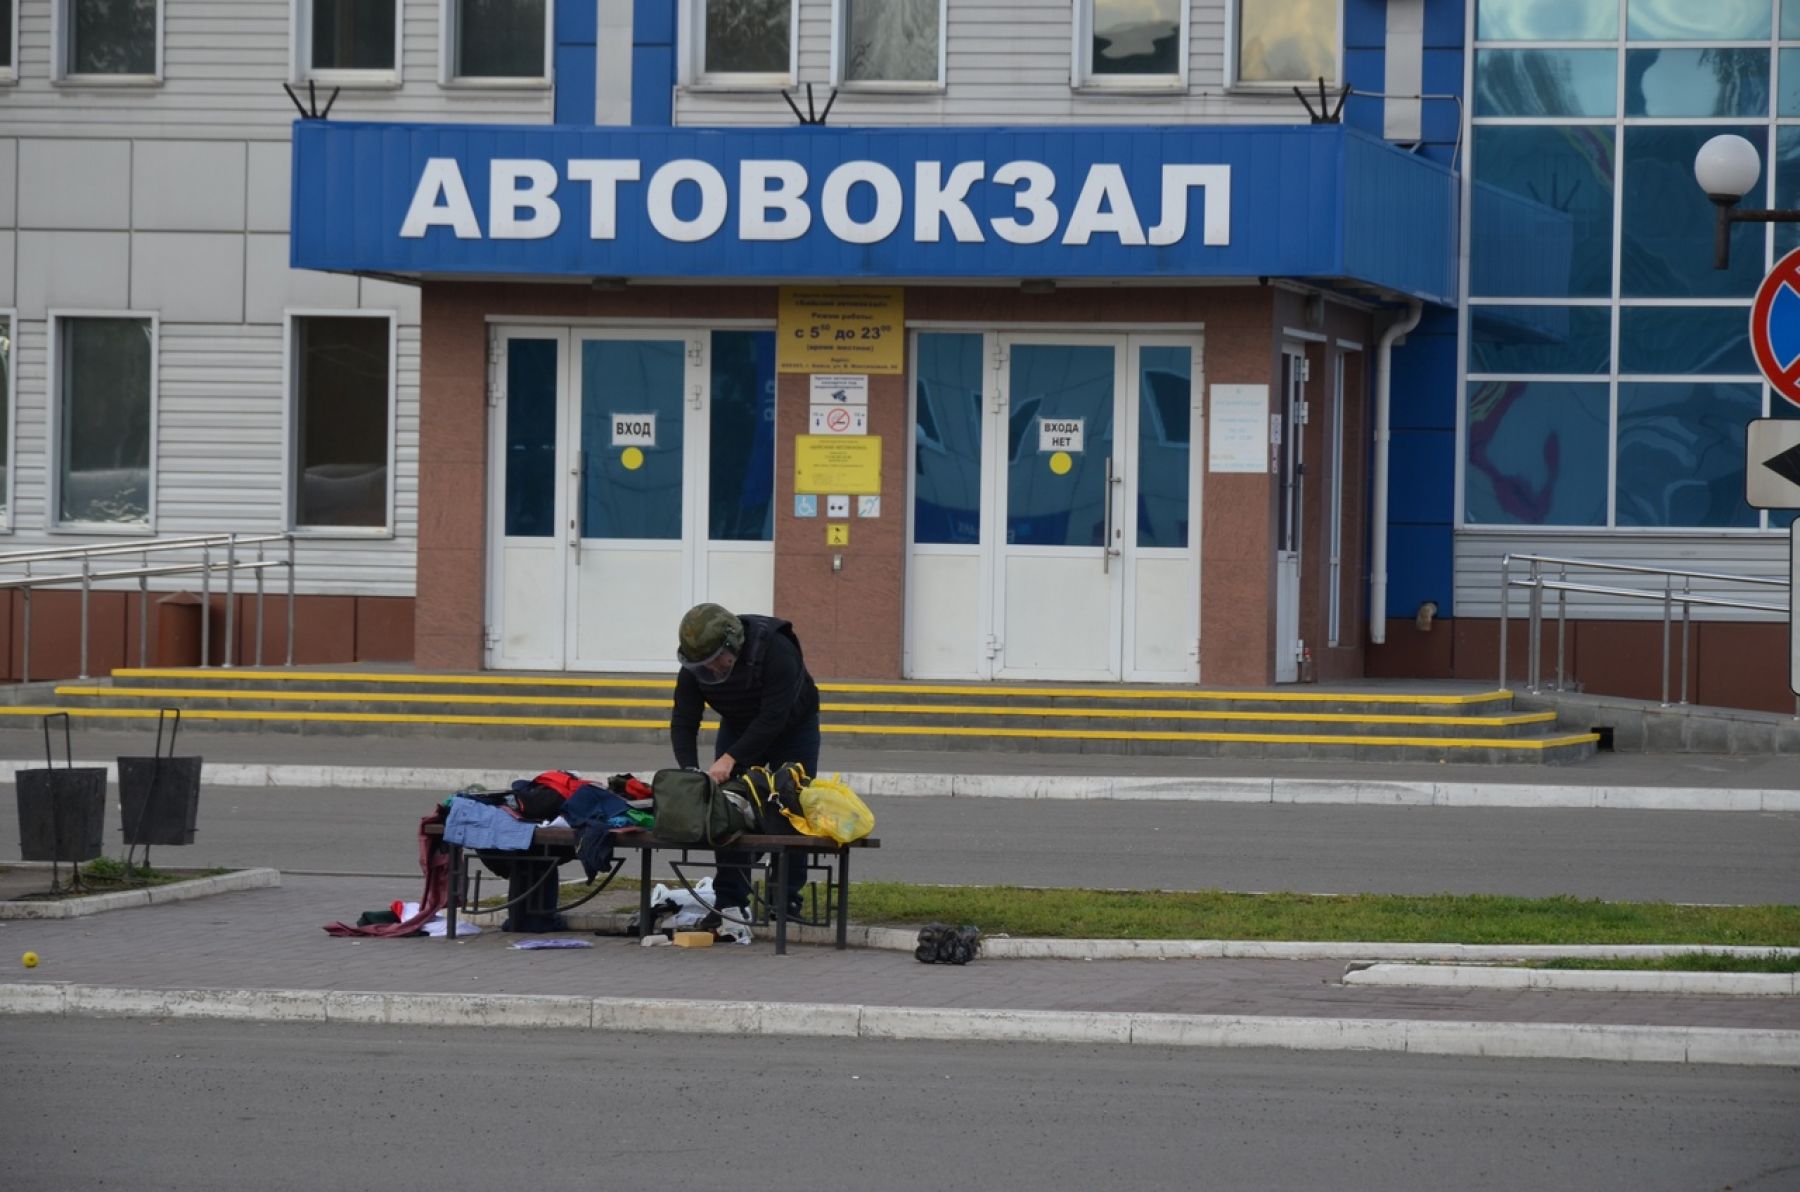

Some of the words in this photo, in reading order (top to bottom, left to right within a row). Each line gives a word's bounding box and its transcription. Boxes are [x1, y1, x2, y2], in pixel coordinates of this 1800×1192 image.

[399, 157, 1232, 247] АВТОВОКЗАЛ
[794, 328, 804, 339] с
[834, 328, 855, 341] до
[616, 422, 652, 438] ВХОД
[1044, 422, 1079, 434] ВХОДА
[1052, 436, 1071, 447] НЕТ
